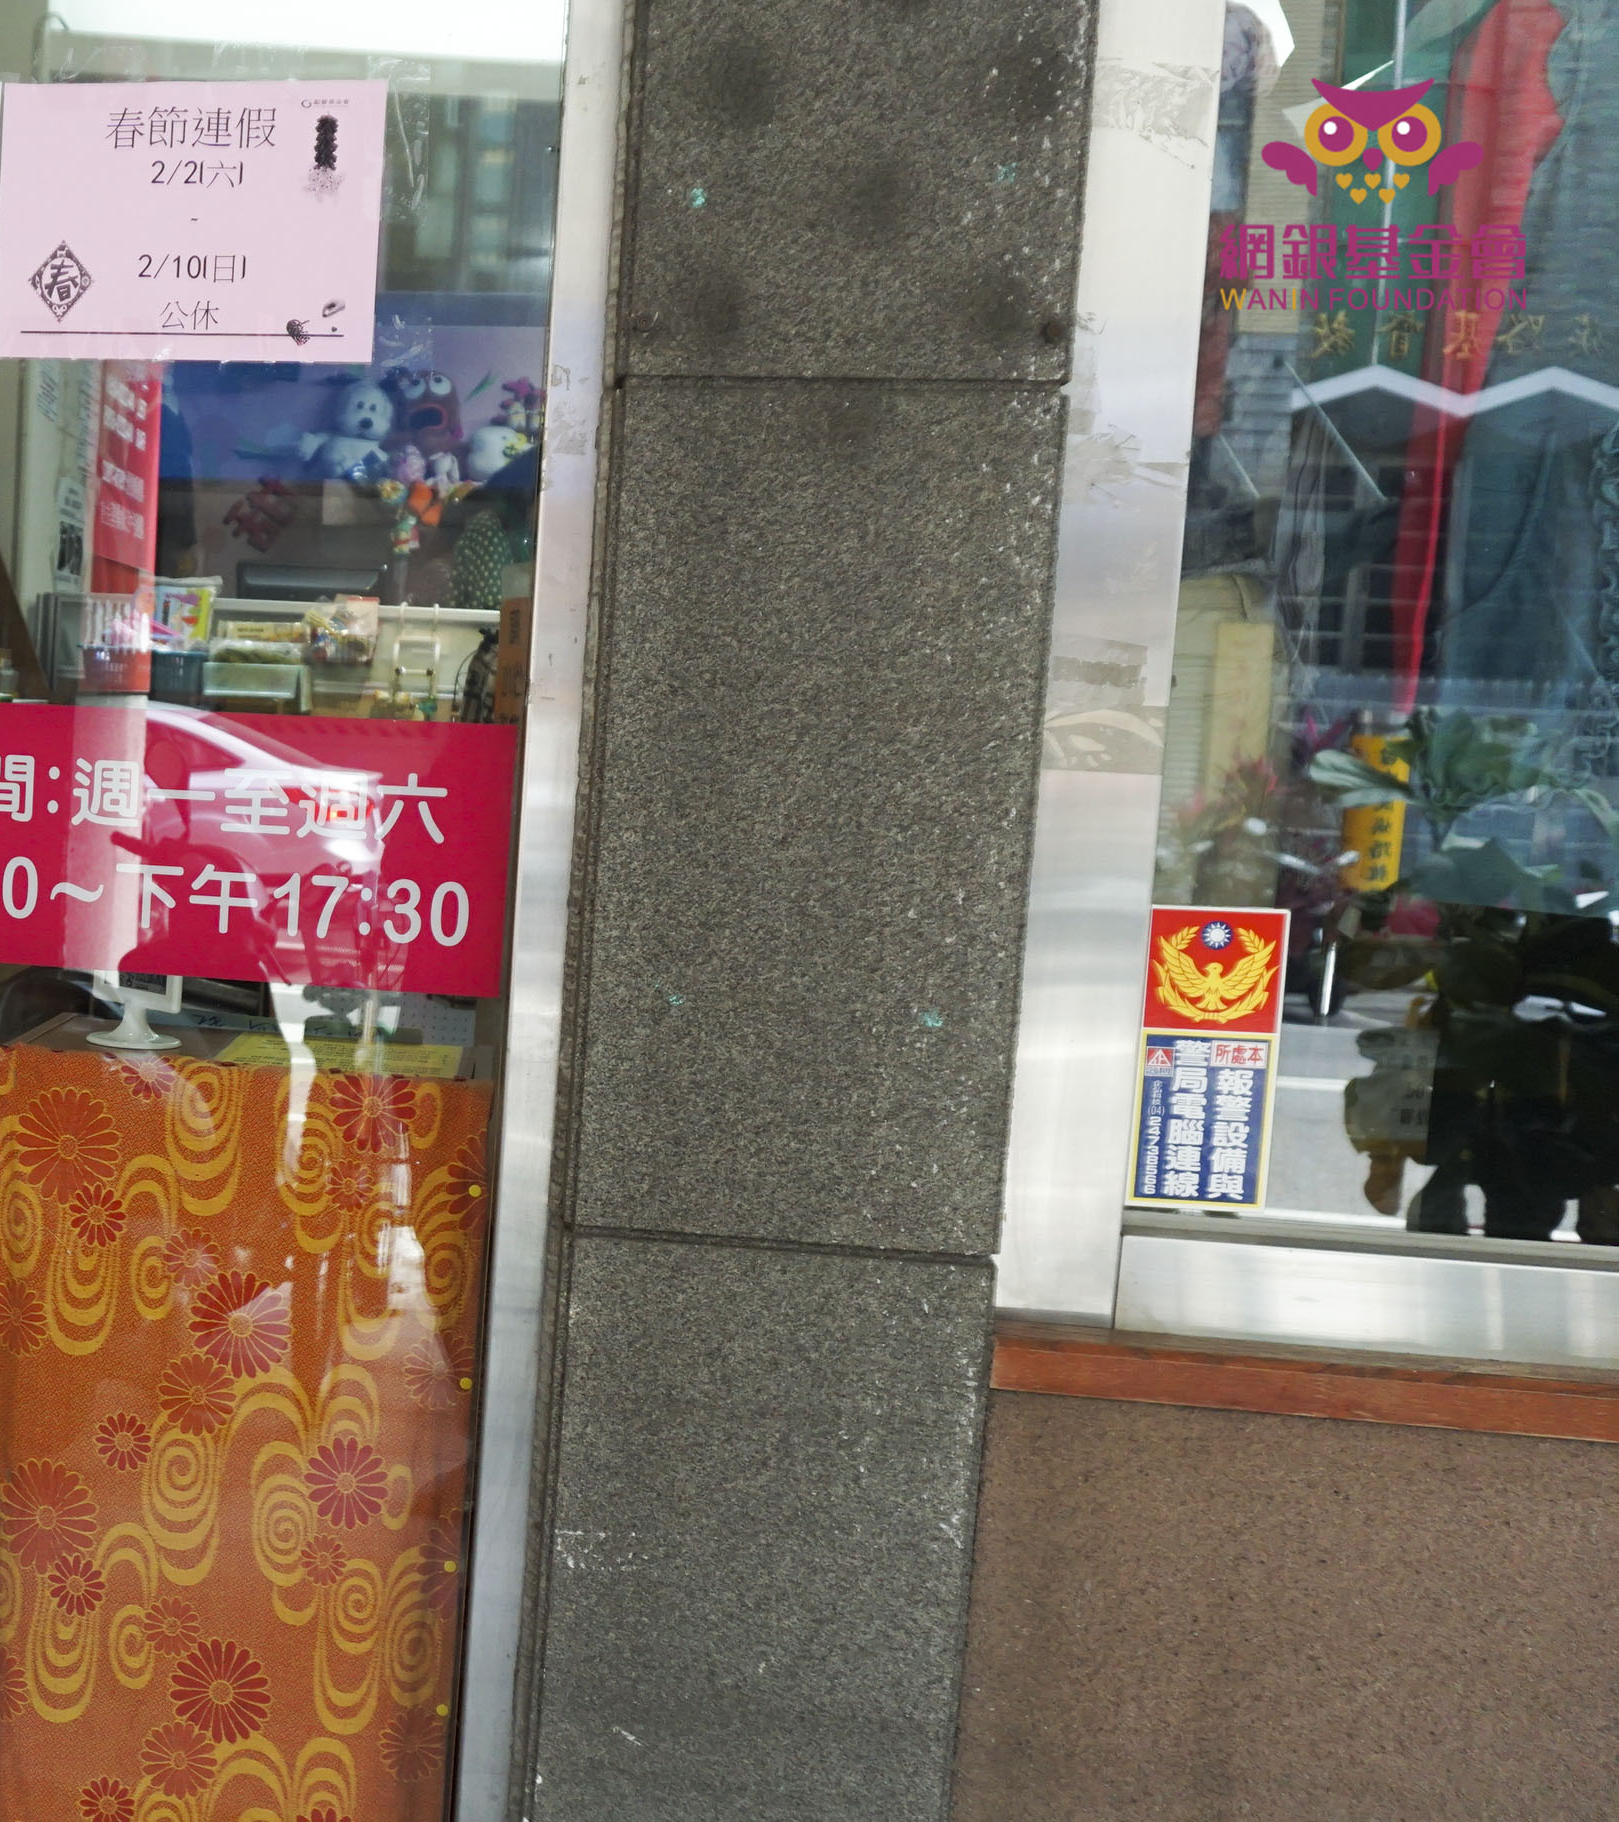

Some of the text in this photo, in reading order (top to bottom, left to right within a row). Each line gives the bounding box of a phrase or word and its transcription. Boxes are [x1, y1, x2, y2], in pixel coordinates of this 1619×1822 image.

[106, 106, 277, 150] 春節連假
[45, 259, 79, 302] 春
[159, 301, 219, 331] 公休
[1162, 1039, 1211, 1198] 警局電腦連線
[1206, 1069, 1255, 1200] 報警設備與
